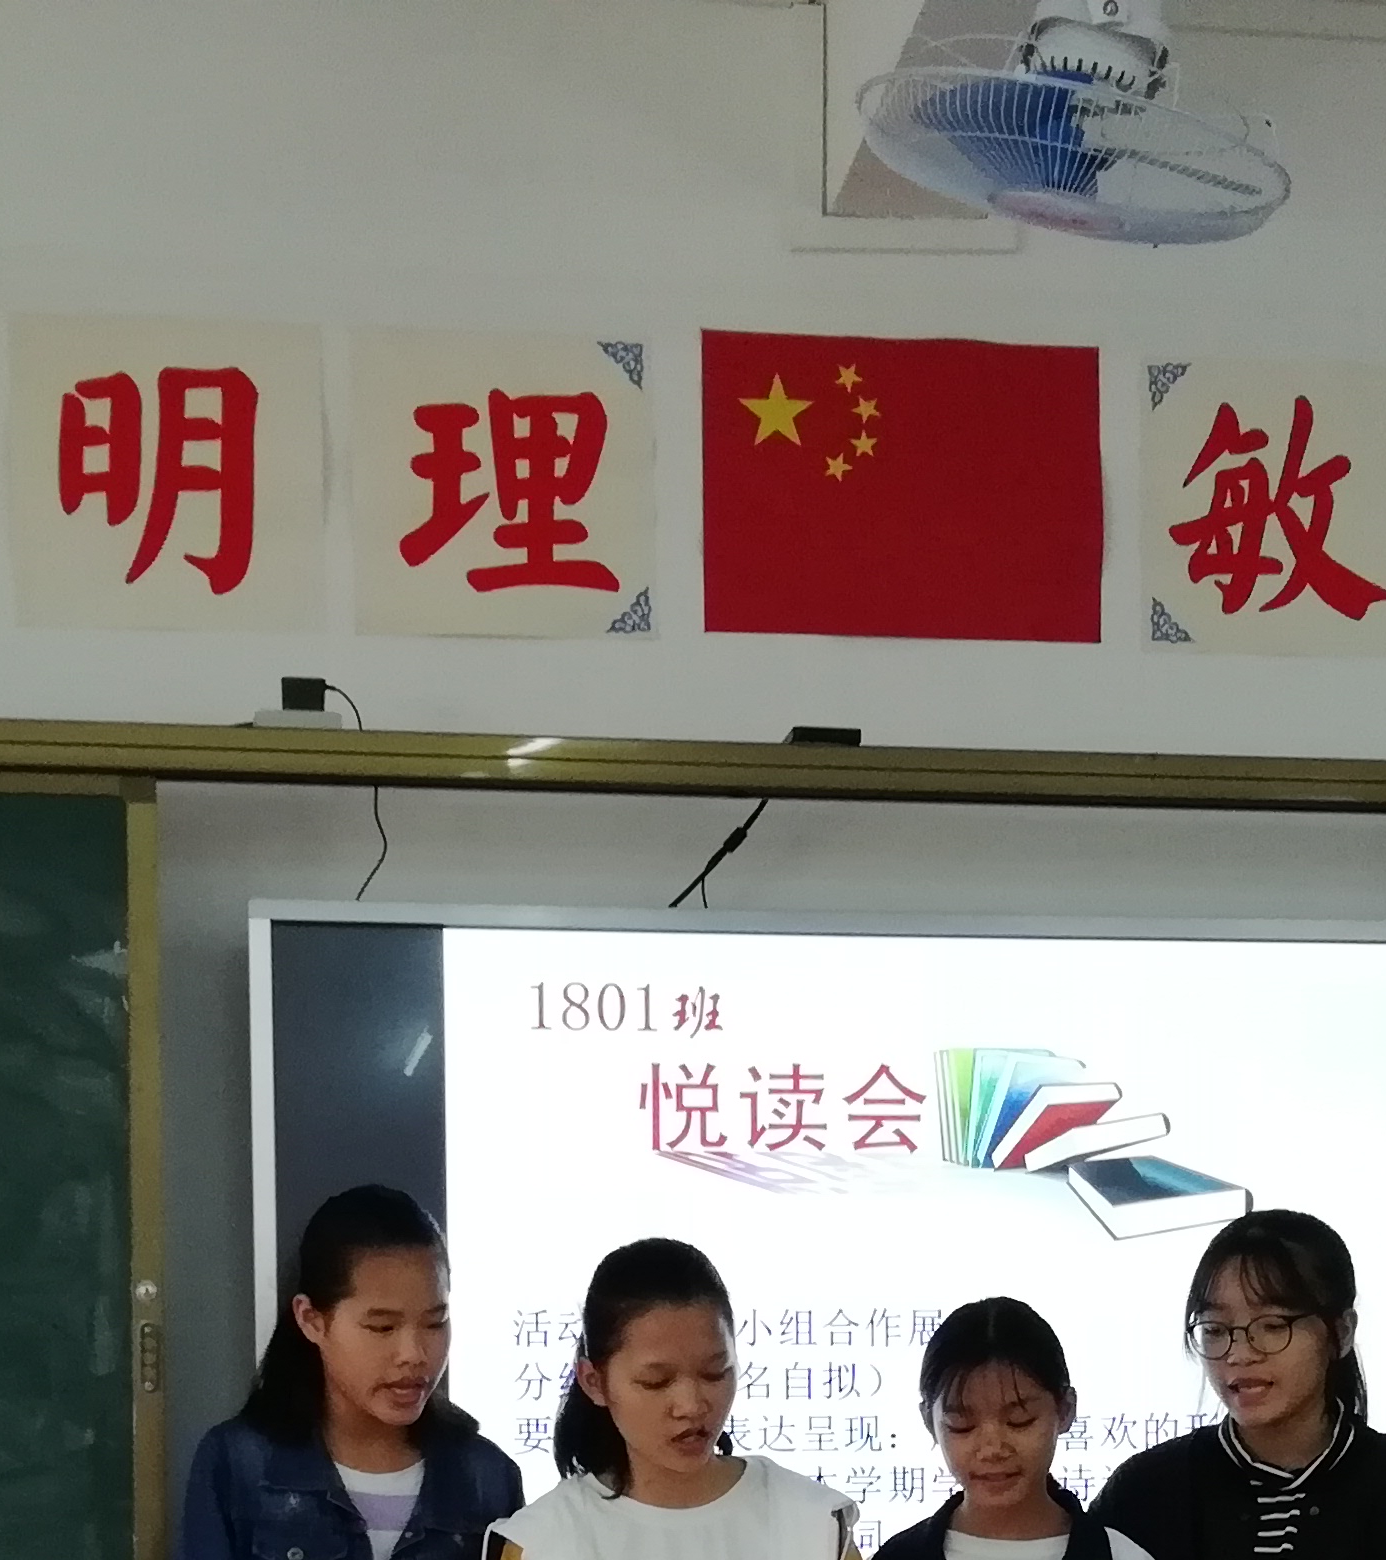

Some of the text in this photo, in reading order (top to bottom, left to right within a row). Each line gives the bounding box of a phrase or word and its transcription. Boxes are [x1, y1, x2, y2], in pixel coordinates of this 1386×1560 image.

[529, 981, 723, 1038] 1801班
[637, 1062, 928, 1155] 悦读会
